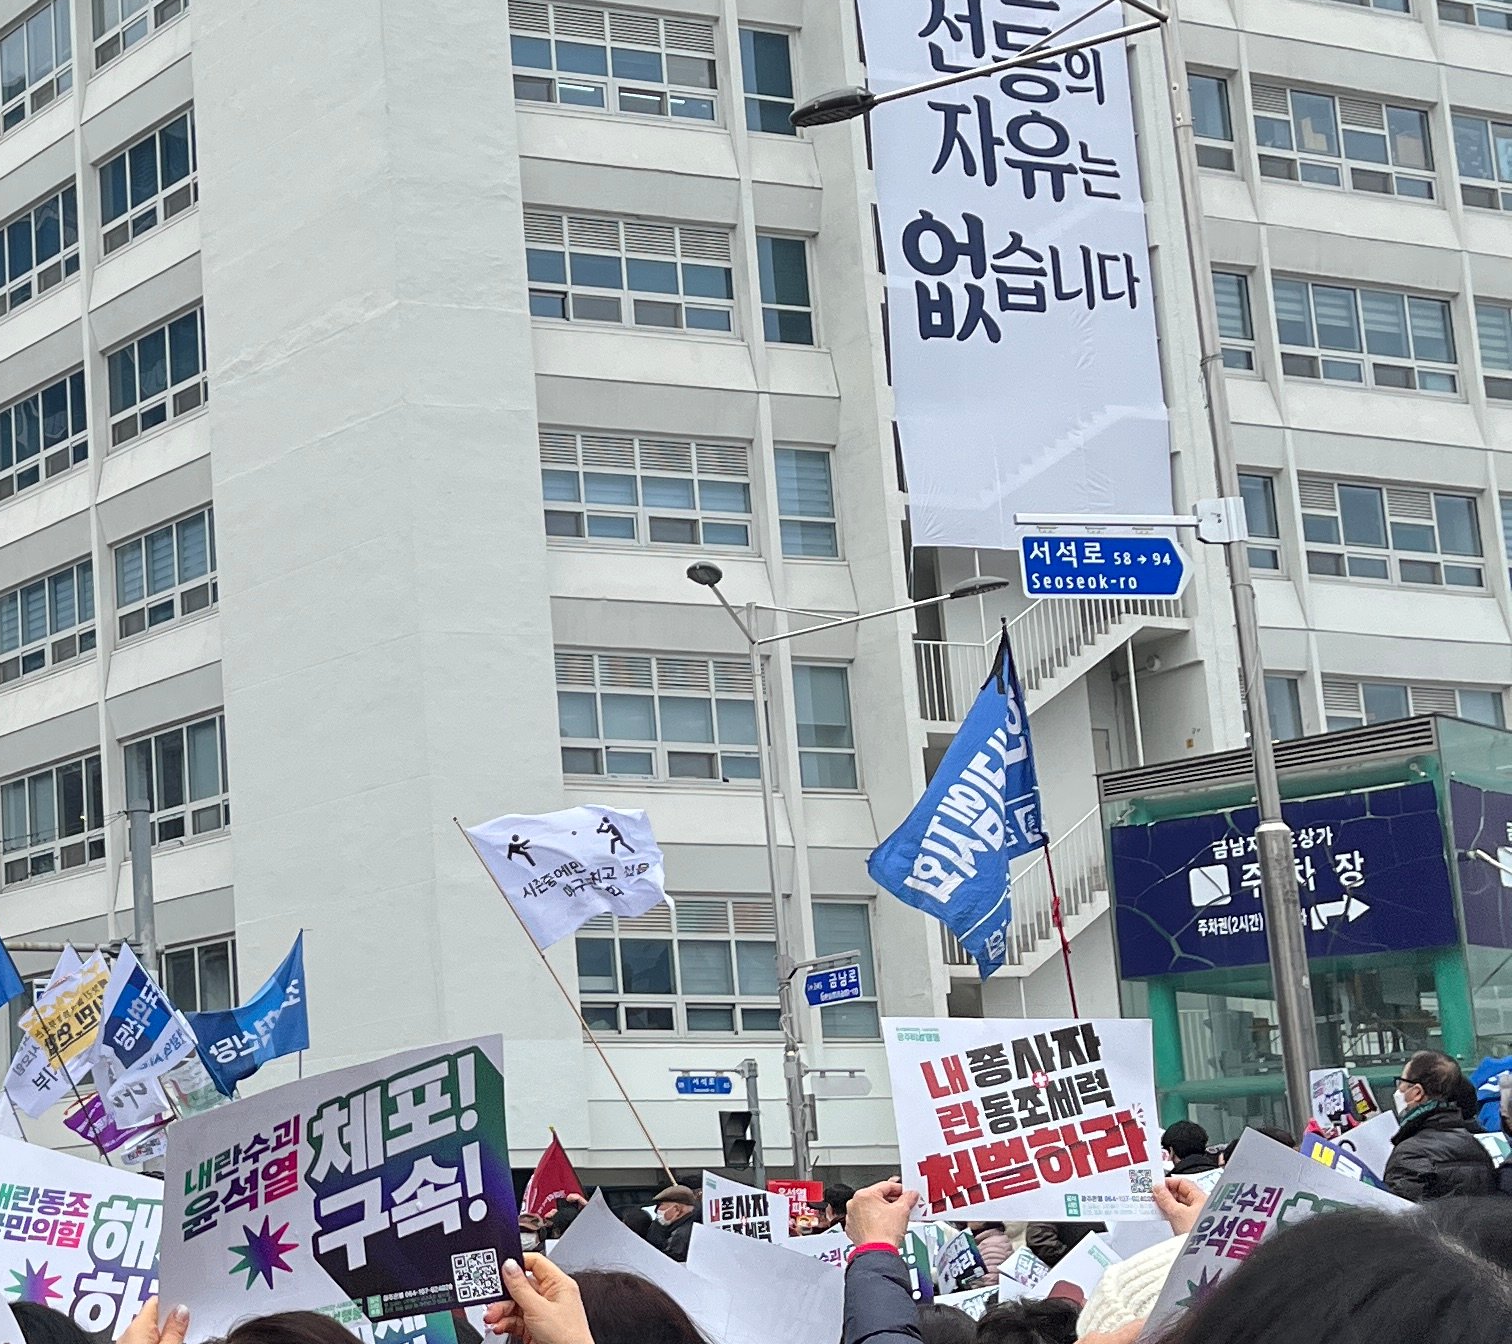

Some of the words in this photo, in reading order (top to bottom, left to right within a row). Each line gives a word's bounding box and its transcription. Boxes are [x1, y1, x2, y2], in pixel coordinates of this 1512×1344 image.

[927, 95, 1122, 202] 자유는
[902, 208, 1140, 343] 없습니다
[1029, 541, 1106, 568] 서석로
[1113, 552, 1132, 566] 58
[1152, 552, 1172, 566] 94
[1031, 573, 1138, 590] Seoseok-ro
[1197, 912, 1264, 937] 주차권(2시간)
[828, 969, 858, 989] 금남로
[965, 1022, 1101, 1089] 종사자
[311, 1052, 480, 1183] 체포!
[980, 1067, 1116, 1135] 동조세력
[184, 1113, 301, 1197] 내란수괴
[917, 1109, 1150, 1214] 처벌하라
[182, 1149, 299, 1242] 윤석열
[318, 1141, 488, 1271] 구속!
[92, 1200, 163, 1270] 해
[73, 1272, 159, 1341] 하
